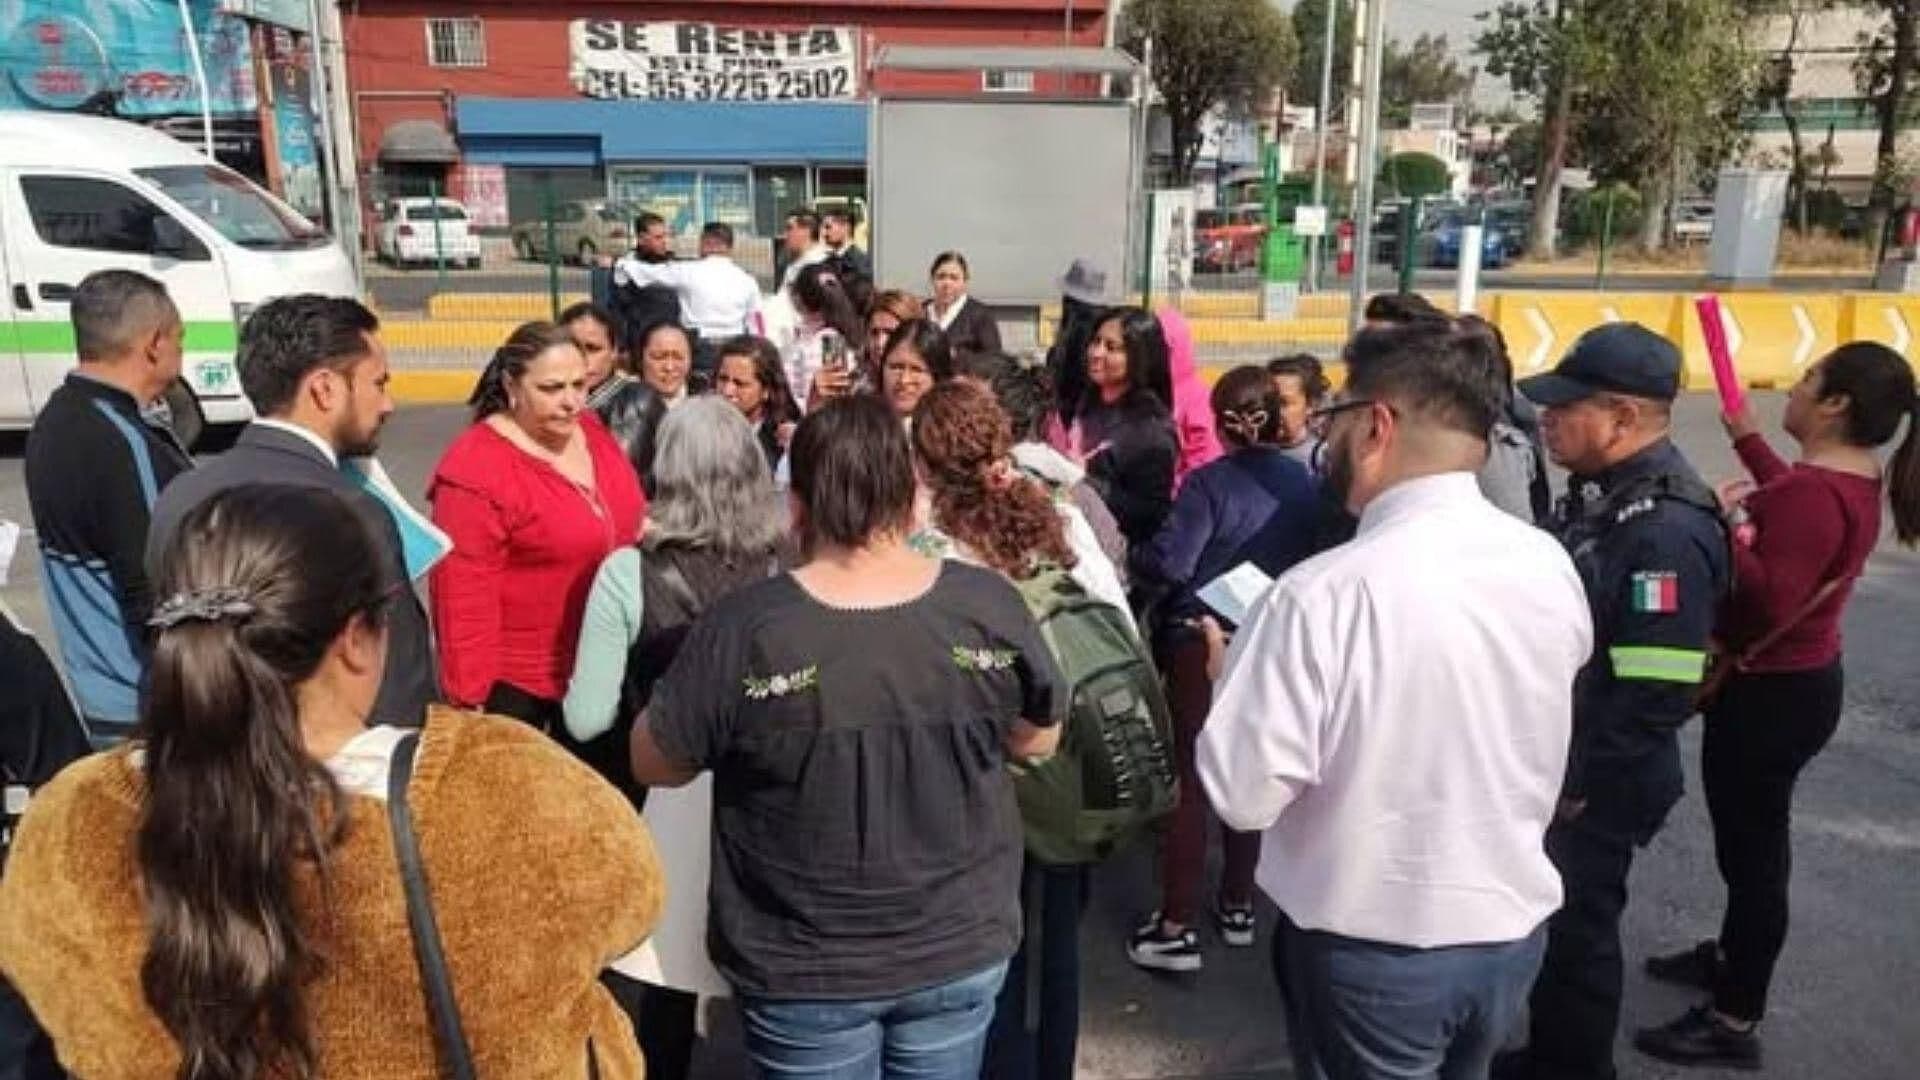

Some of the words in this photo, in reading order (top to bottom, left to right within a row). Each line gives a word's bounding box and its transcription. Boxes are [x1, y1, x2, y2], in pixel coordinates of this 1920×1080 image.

[585, 21, 649, 51] SE
[676, 23, 841, 56] RENTA
[776, 66, 849, 98] 2502
